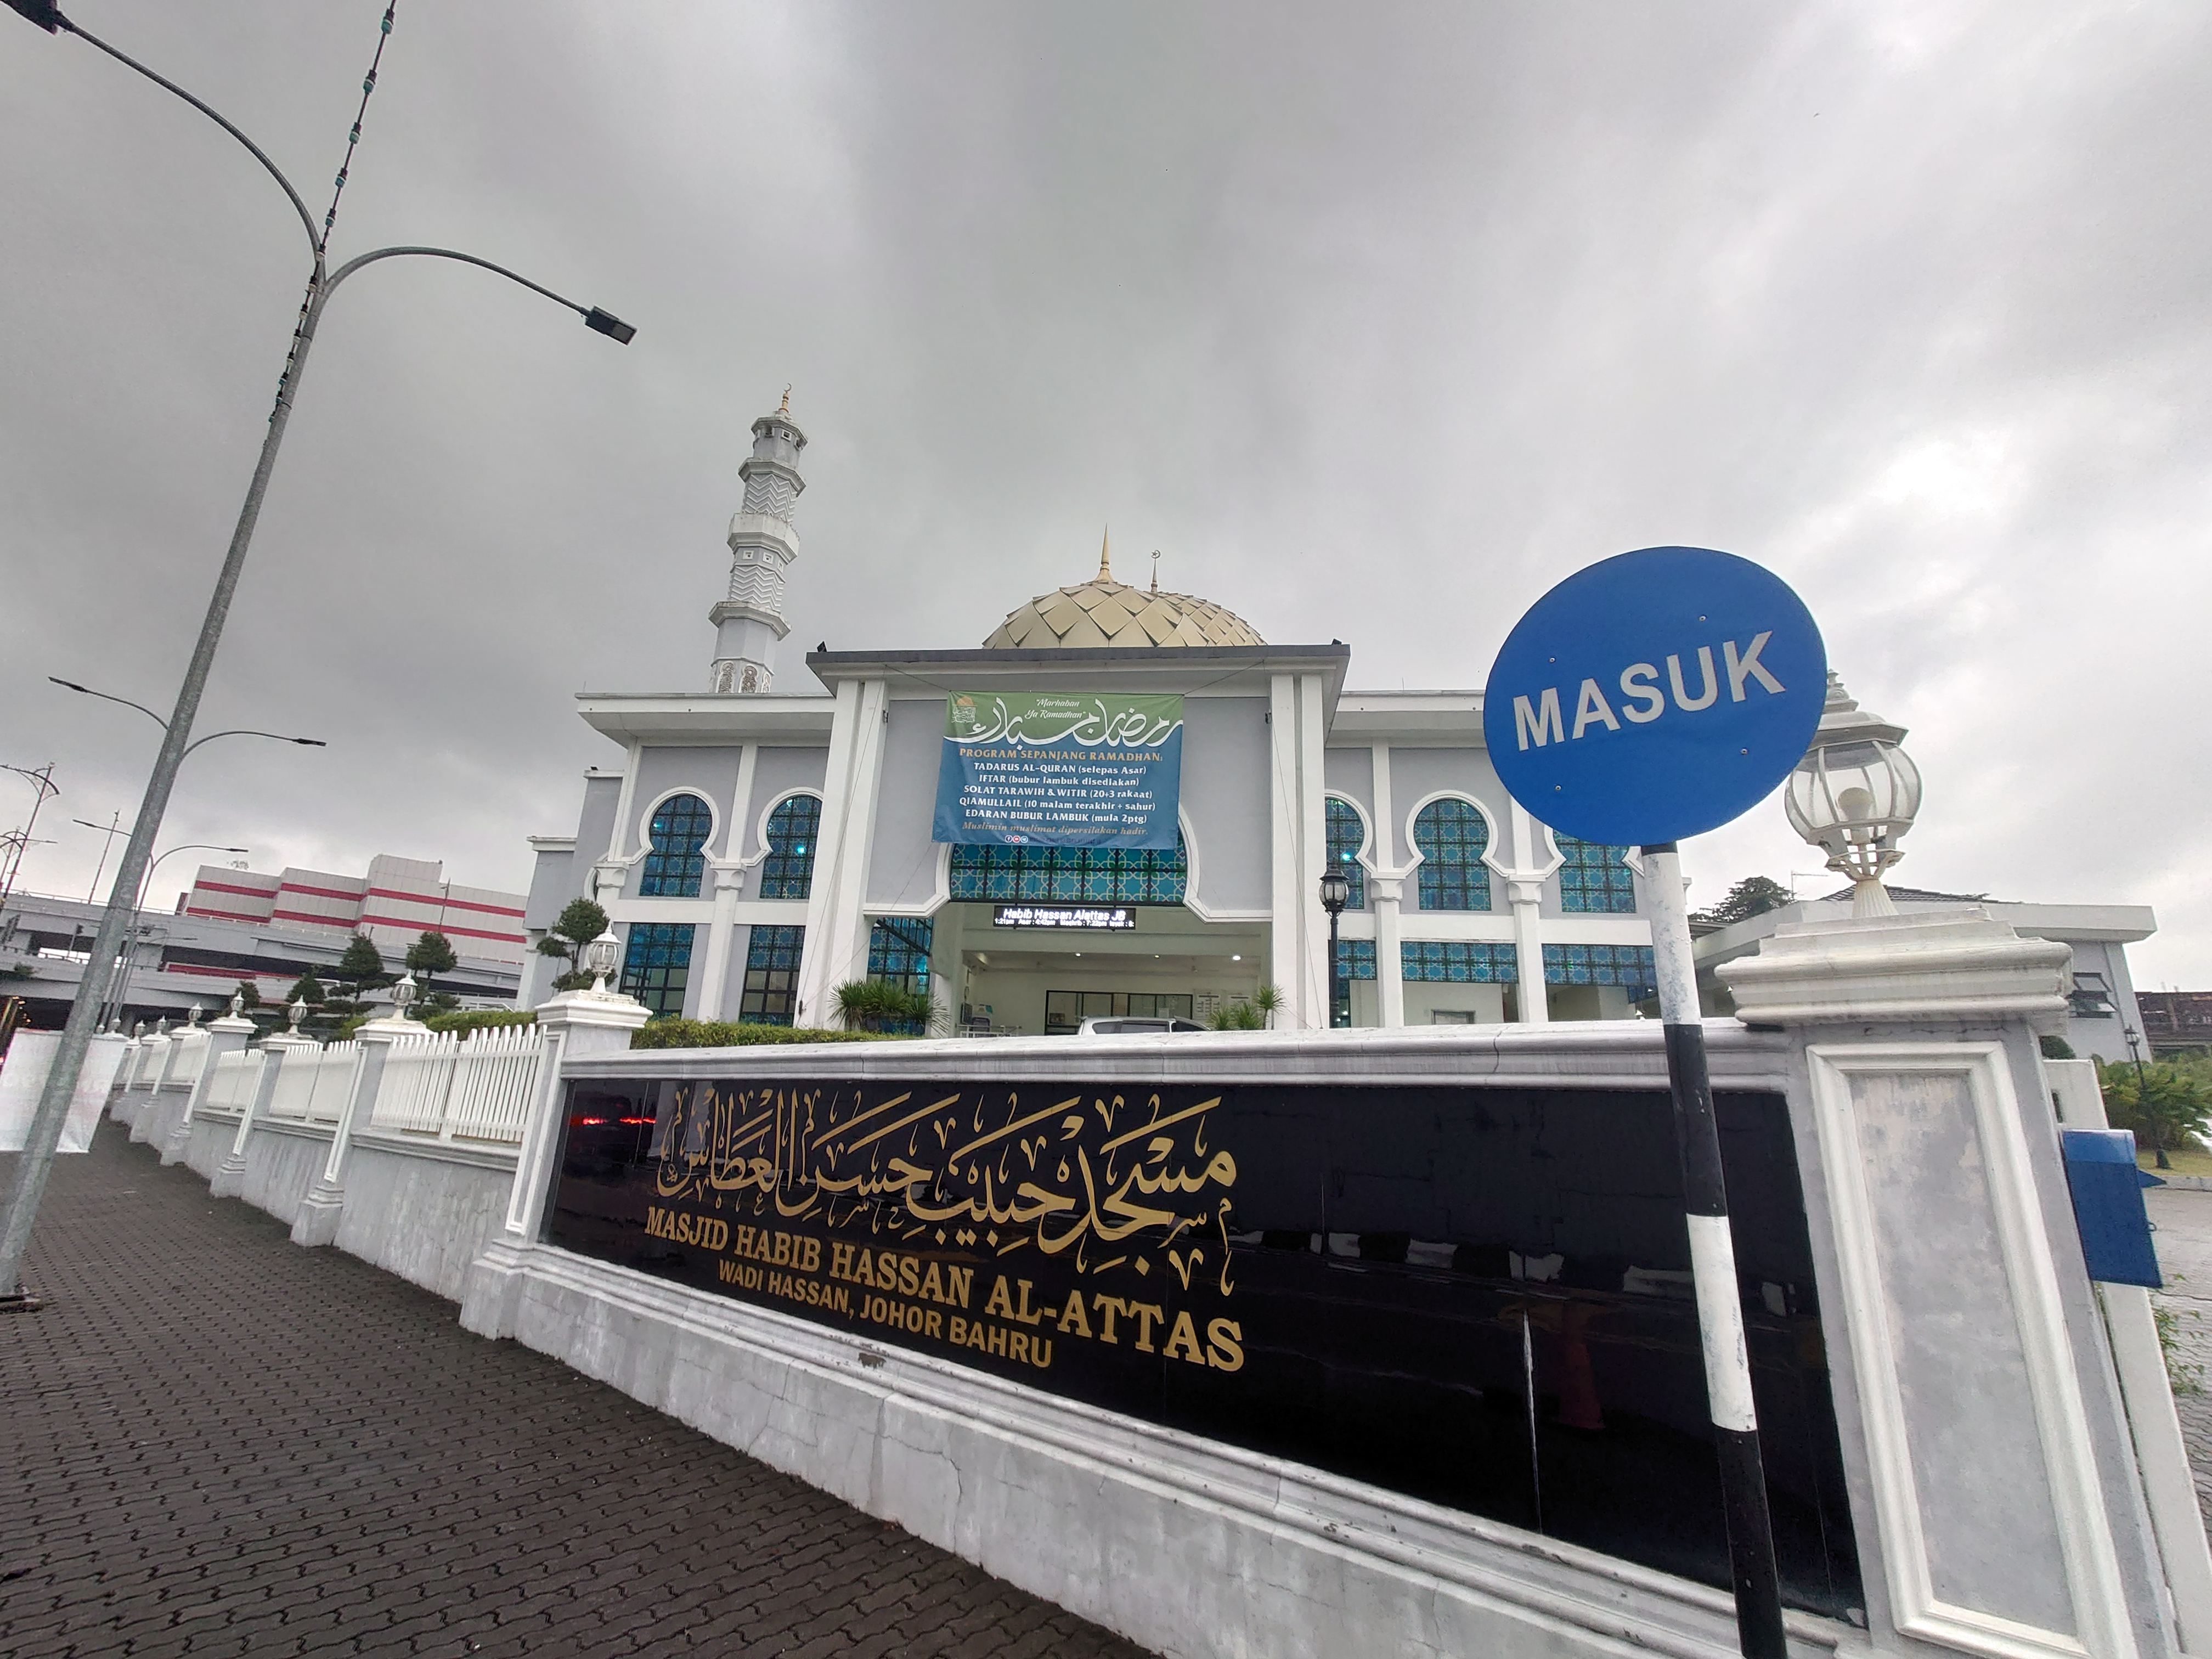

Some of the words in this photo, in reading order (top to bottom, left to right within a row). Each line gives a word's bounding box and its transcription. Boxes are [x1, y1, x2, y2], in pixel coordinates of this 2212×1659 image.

[1513, 630, 1786, 751] MASUK
[1024, 709, 1039, 719] Ya
[960, 748, 1017, 758] PROGRAM
[1020, 750, 1086, 761] SEPANJANG
[1090, 752, 1163, 761] RAMADHAN:
[974, 763, 1020, 771] TADARUS
[1022, 764, 1076, 773] AL-QURAN
[1079, 765, 1118, 775] (selepas
[1121, 766, 1147, 774] Asar)
[979, 775, 1006, 783] IFTAR
[1009, 775, 1040, 784] (bubur
[1043, 776, 1079, 785] lambuk
[1082, 777, 1139, 786] disediakan)
[964, 785, 996, 794] SOLAT
[998, 787, 1045, 795] TARAWIH
[1057, 789, 1087, 797] WITIR
[1090, 790, 1115, 798] (20+3
[1117, 791, 1153, 799] rakaat)
[960, 797, 1022, 807] QIAMULLAIL
[1024, 799, 1037, 808] (10
[1040, 800, 1073, 809] malam
[1125, 803, 1156, 811] sahur)
[966, 809, 1007, 819] EDARAN
[1010, 811, 1043, 820] BUBUR
[1046, 812, 1089, 821] LAMBUK
[1092, 814, 1119, 822] (mula
[1122, 814, 1147, 824] 2ptg)
[962, 822, 1007, 831] Muslimin
[1010, 824, 1056, 833] muslimat
[1058, 825, 1118, 835] dipersilakan
[1120, 826, 1148, 835] hadir.
[1003, 908, 1032, 919] Habib
[1034, 909, 1073, 920] Hassan
[1073, 910, 1110, 921] Alattas
[1111, 910, 1126, 921] JB
[644, 1206, 730, 1251] MASJID
[734, 1224, 822, 1273] HABIB
[829, 1242, 974, 1309] HASSAN
[984, 1274, 1245, 1372] AL-ATTAS
[718, 1259, 764, 1291] WADI
[768, 1272, 855, 1320] HASSAN,
[860, 1294, 941, 1339] JOHOR
[950, 1316, 1052, 1368] BAHRU
